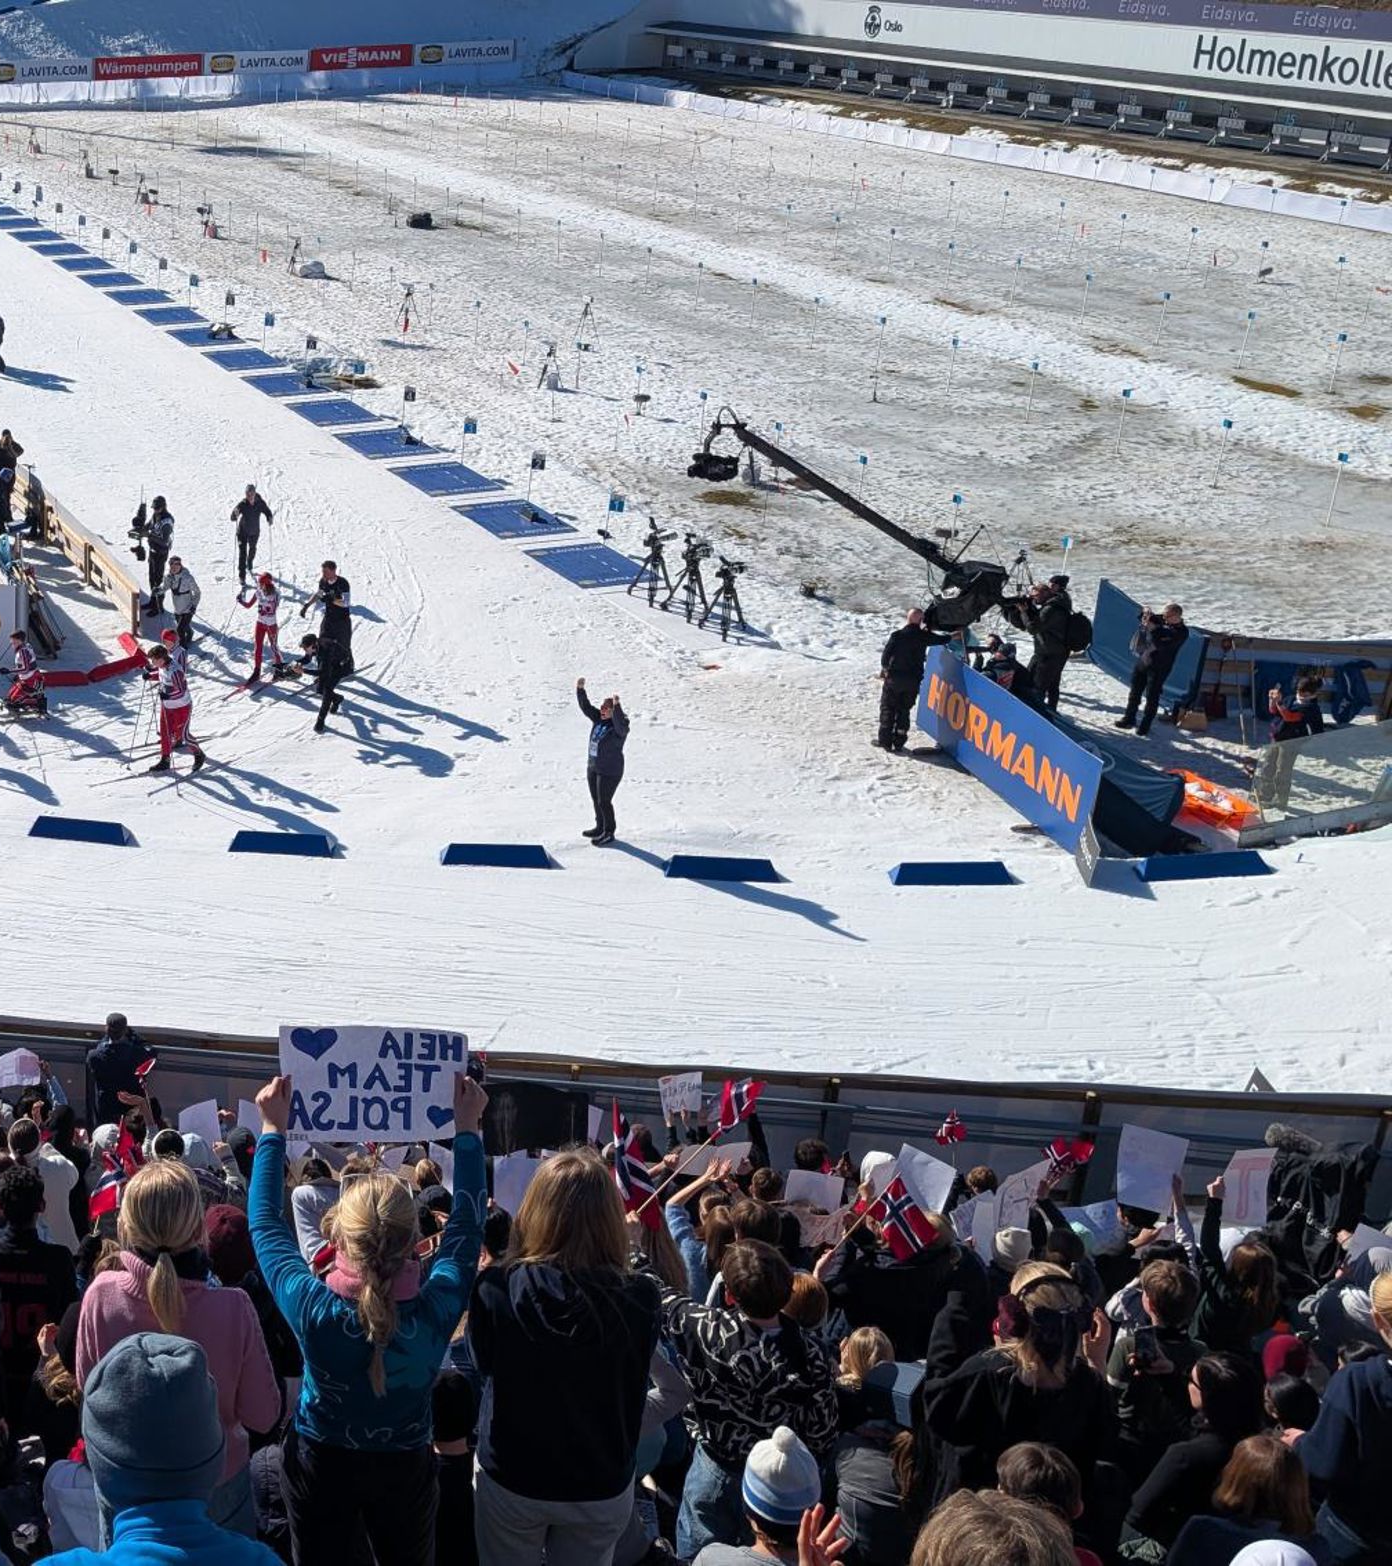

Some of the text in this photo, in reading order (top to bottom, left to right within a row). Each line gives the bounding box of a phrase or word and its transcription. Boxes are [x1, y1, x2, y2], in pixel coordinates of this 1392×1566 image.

[884, 20, 903, 33] Oslo
[321, 47, 401, 68] VIESSMANN
[448, 45, 509, 59] LAVITA.COM
[98, 59, 198, 75] Wärmepumpen
[240, 56, 304, 69] LAVITA.COM
[21, 64, 88, 77] LAVITA.COM
[926, 673, 1084, 823] HÖRMANN
